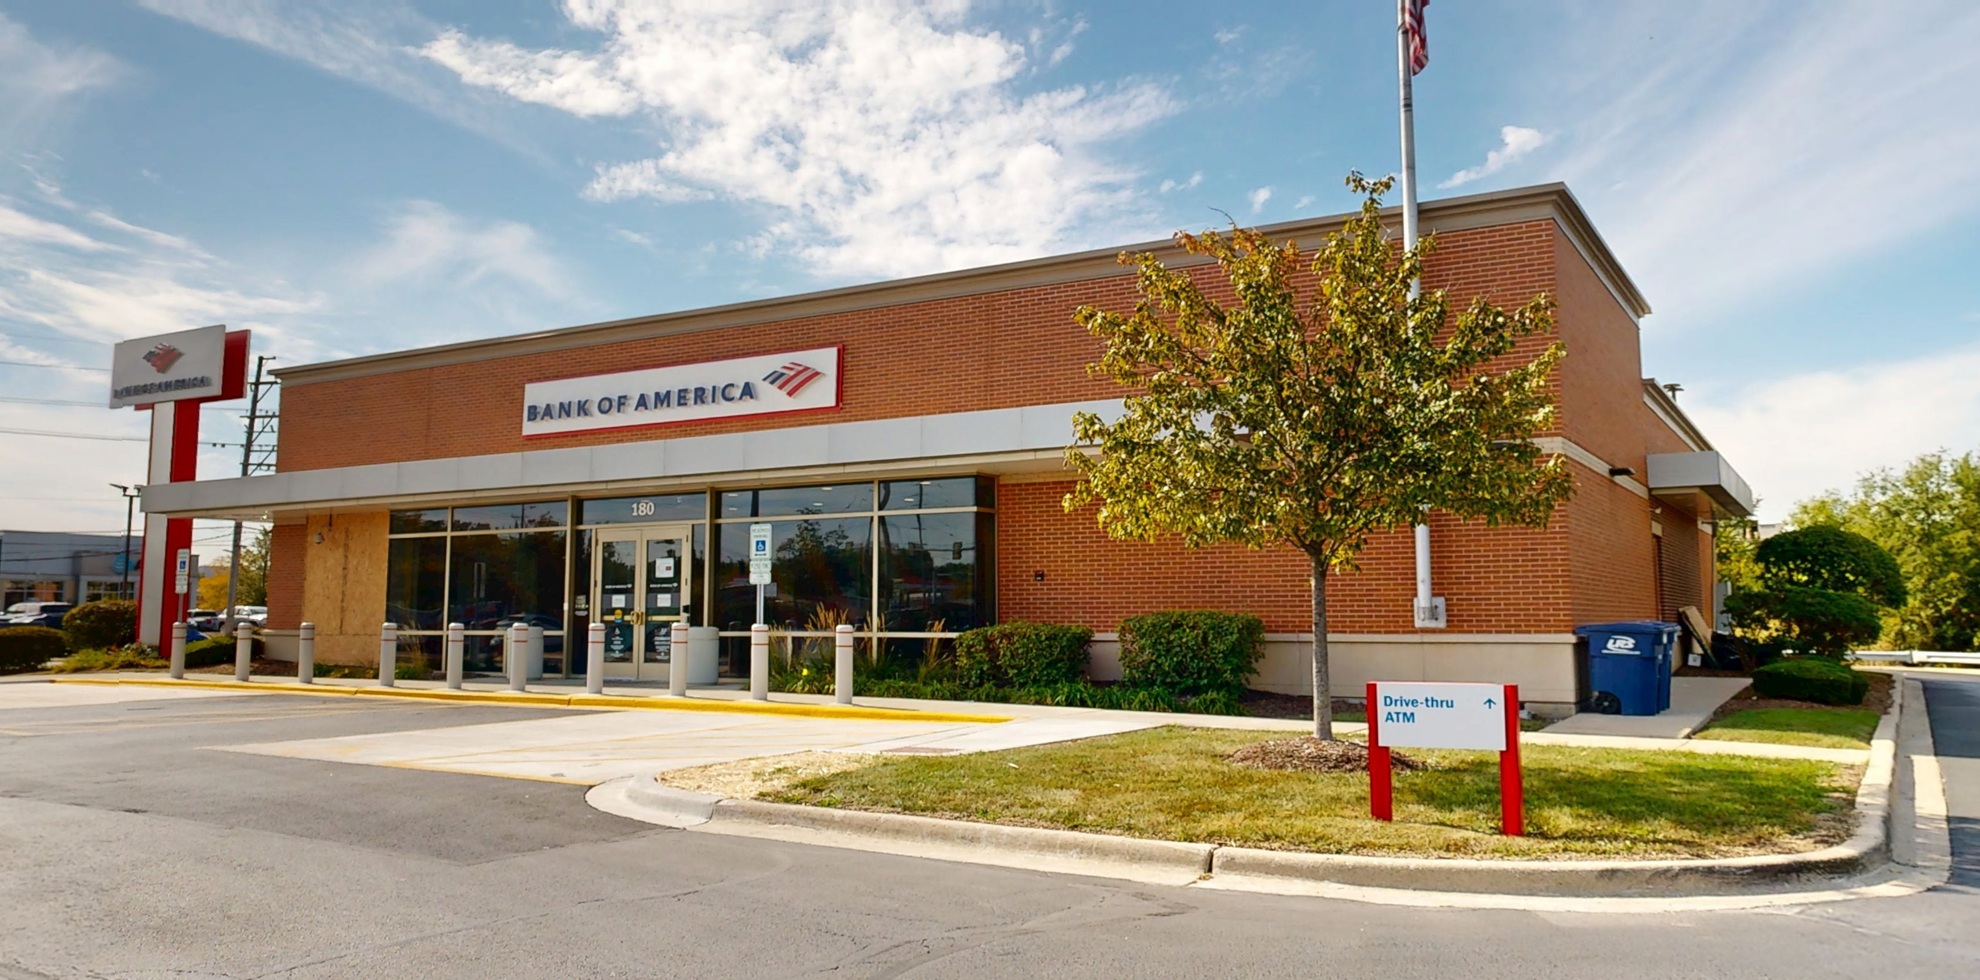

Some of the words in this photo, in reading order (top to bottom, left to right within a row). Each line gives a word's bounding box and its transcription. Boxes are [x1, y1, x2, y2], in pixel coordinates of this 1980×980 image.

[527, 399, 591, 422] BANK
[597, 395, 628, 415] OF
[634, 381, 755, 411] AMERICA
[631, 502, 655, 516] 180
[1383, 695, 1454, 709] Drive-thru
[1384, 711, 1416, 723] ATM
